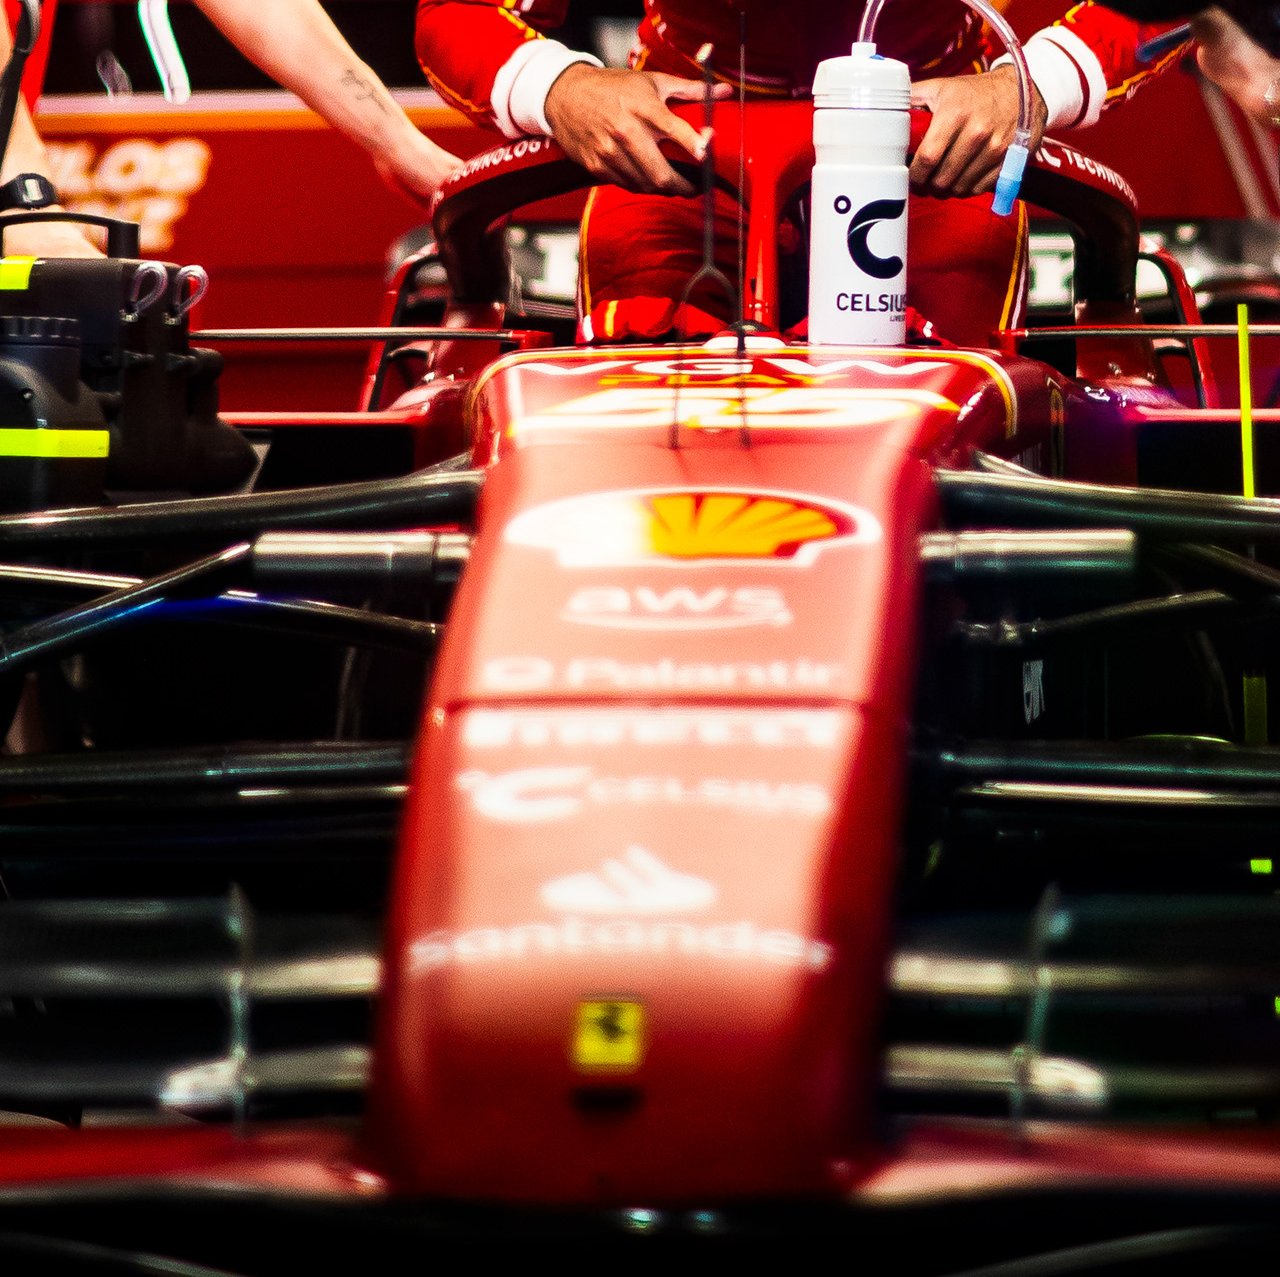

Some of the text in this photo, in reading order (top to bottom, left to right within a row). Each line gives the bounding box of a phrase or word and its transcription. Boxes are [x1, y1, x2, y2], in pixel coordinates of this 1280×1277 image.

[517, 358, 952, 376] VGW
[599, 374, 851, 386] PLAY
[567, 585, 787, 614] aws
[566, 657, 841, 689] Palantir
